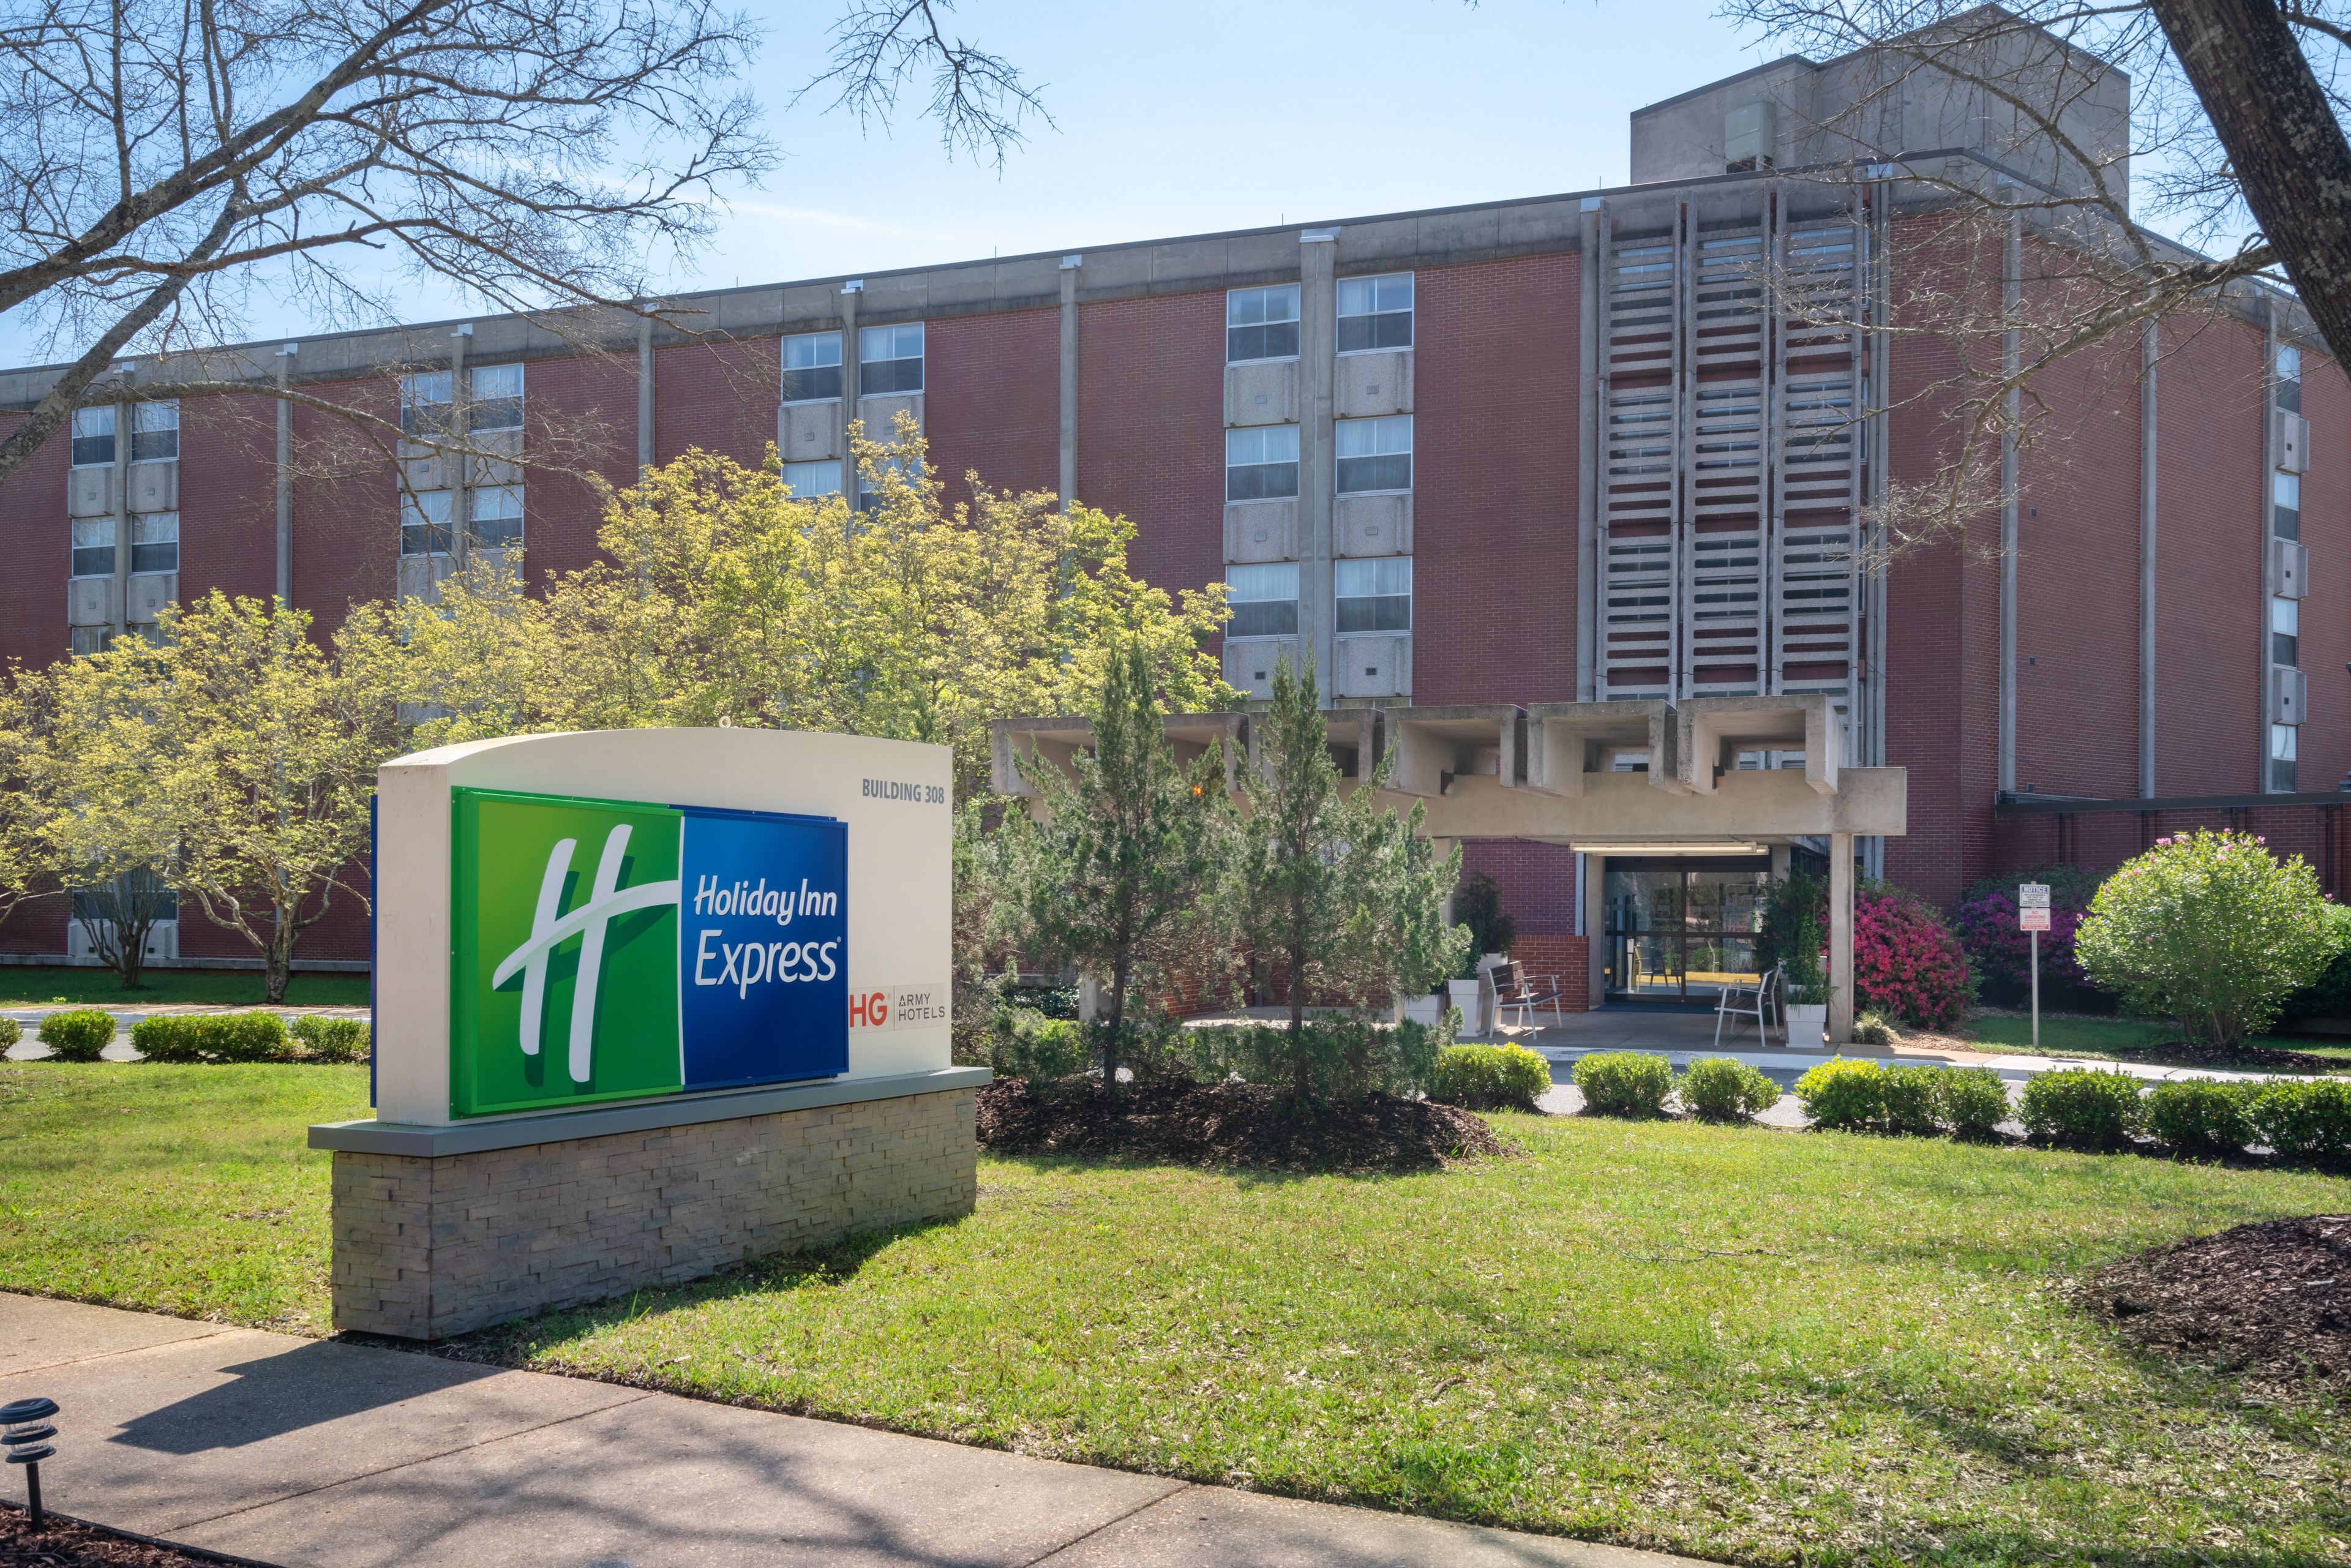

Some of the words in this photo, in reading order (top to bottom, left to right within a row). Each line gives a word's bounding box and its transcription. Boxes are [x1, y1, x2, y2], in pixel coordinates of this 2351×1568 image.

[862, 778, 921, 802] BUILDING
[924, 785, 945, 805] 308
[694, 875, 796, 926] Holiday
[798, 879, 837, 917] Inn
[695, 929, 838, 1000] Express
[898, 993, 931, 1007] ARMY
[898, 1006, 945, 1021] HOTELS
